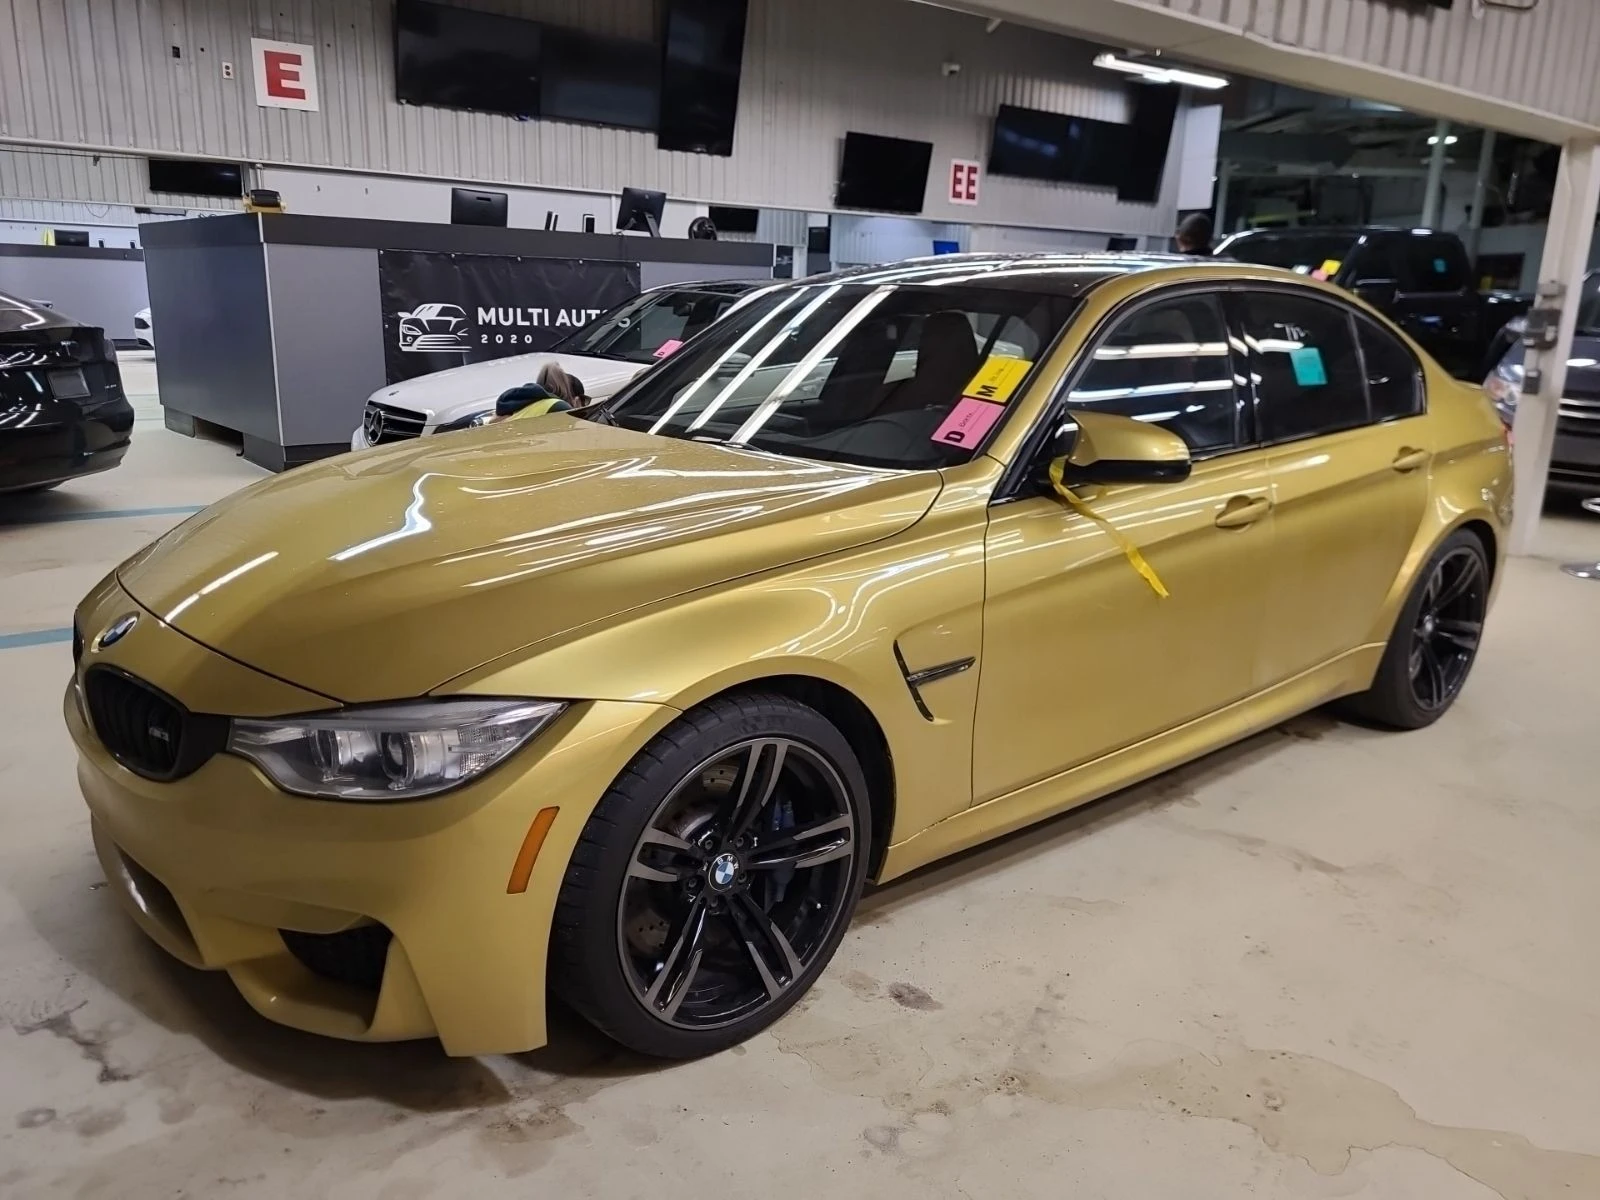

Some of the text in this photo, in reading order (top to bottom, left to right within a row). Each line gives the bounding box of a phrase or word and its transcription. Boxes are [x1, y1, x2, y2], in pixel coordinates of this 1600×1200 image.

[264, 50, 305, 100] E
[952, 164, 977, 199] EE
[478, 307, 630, 328] MULTI AUTS
[481, 334, 532, 344] 2020
[976, 385, 998, 397] M
[944, 431, 965, 443] D
